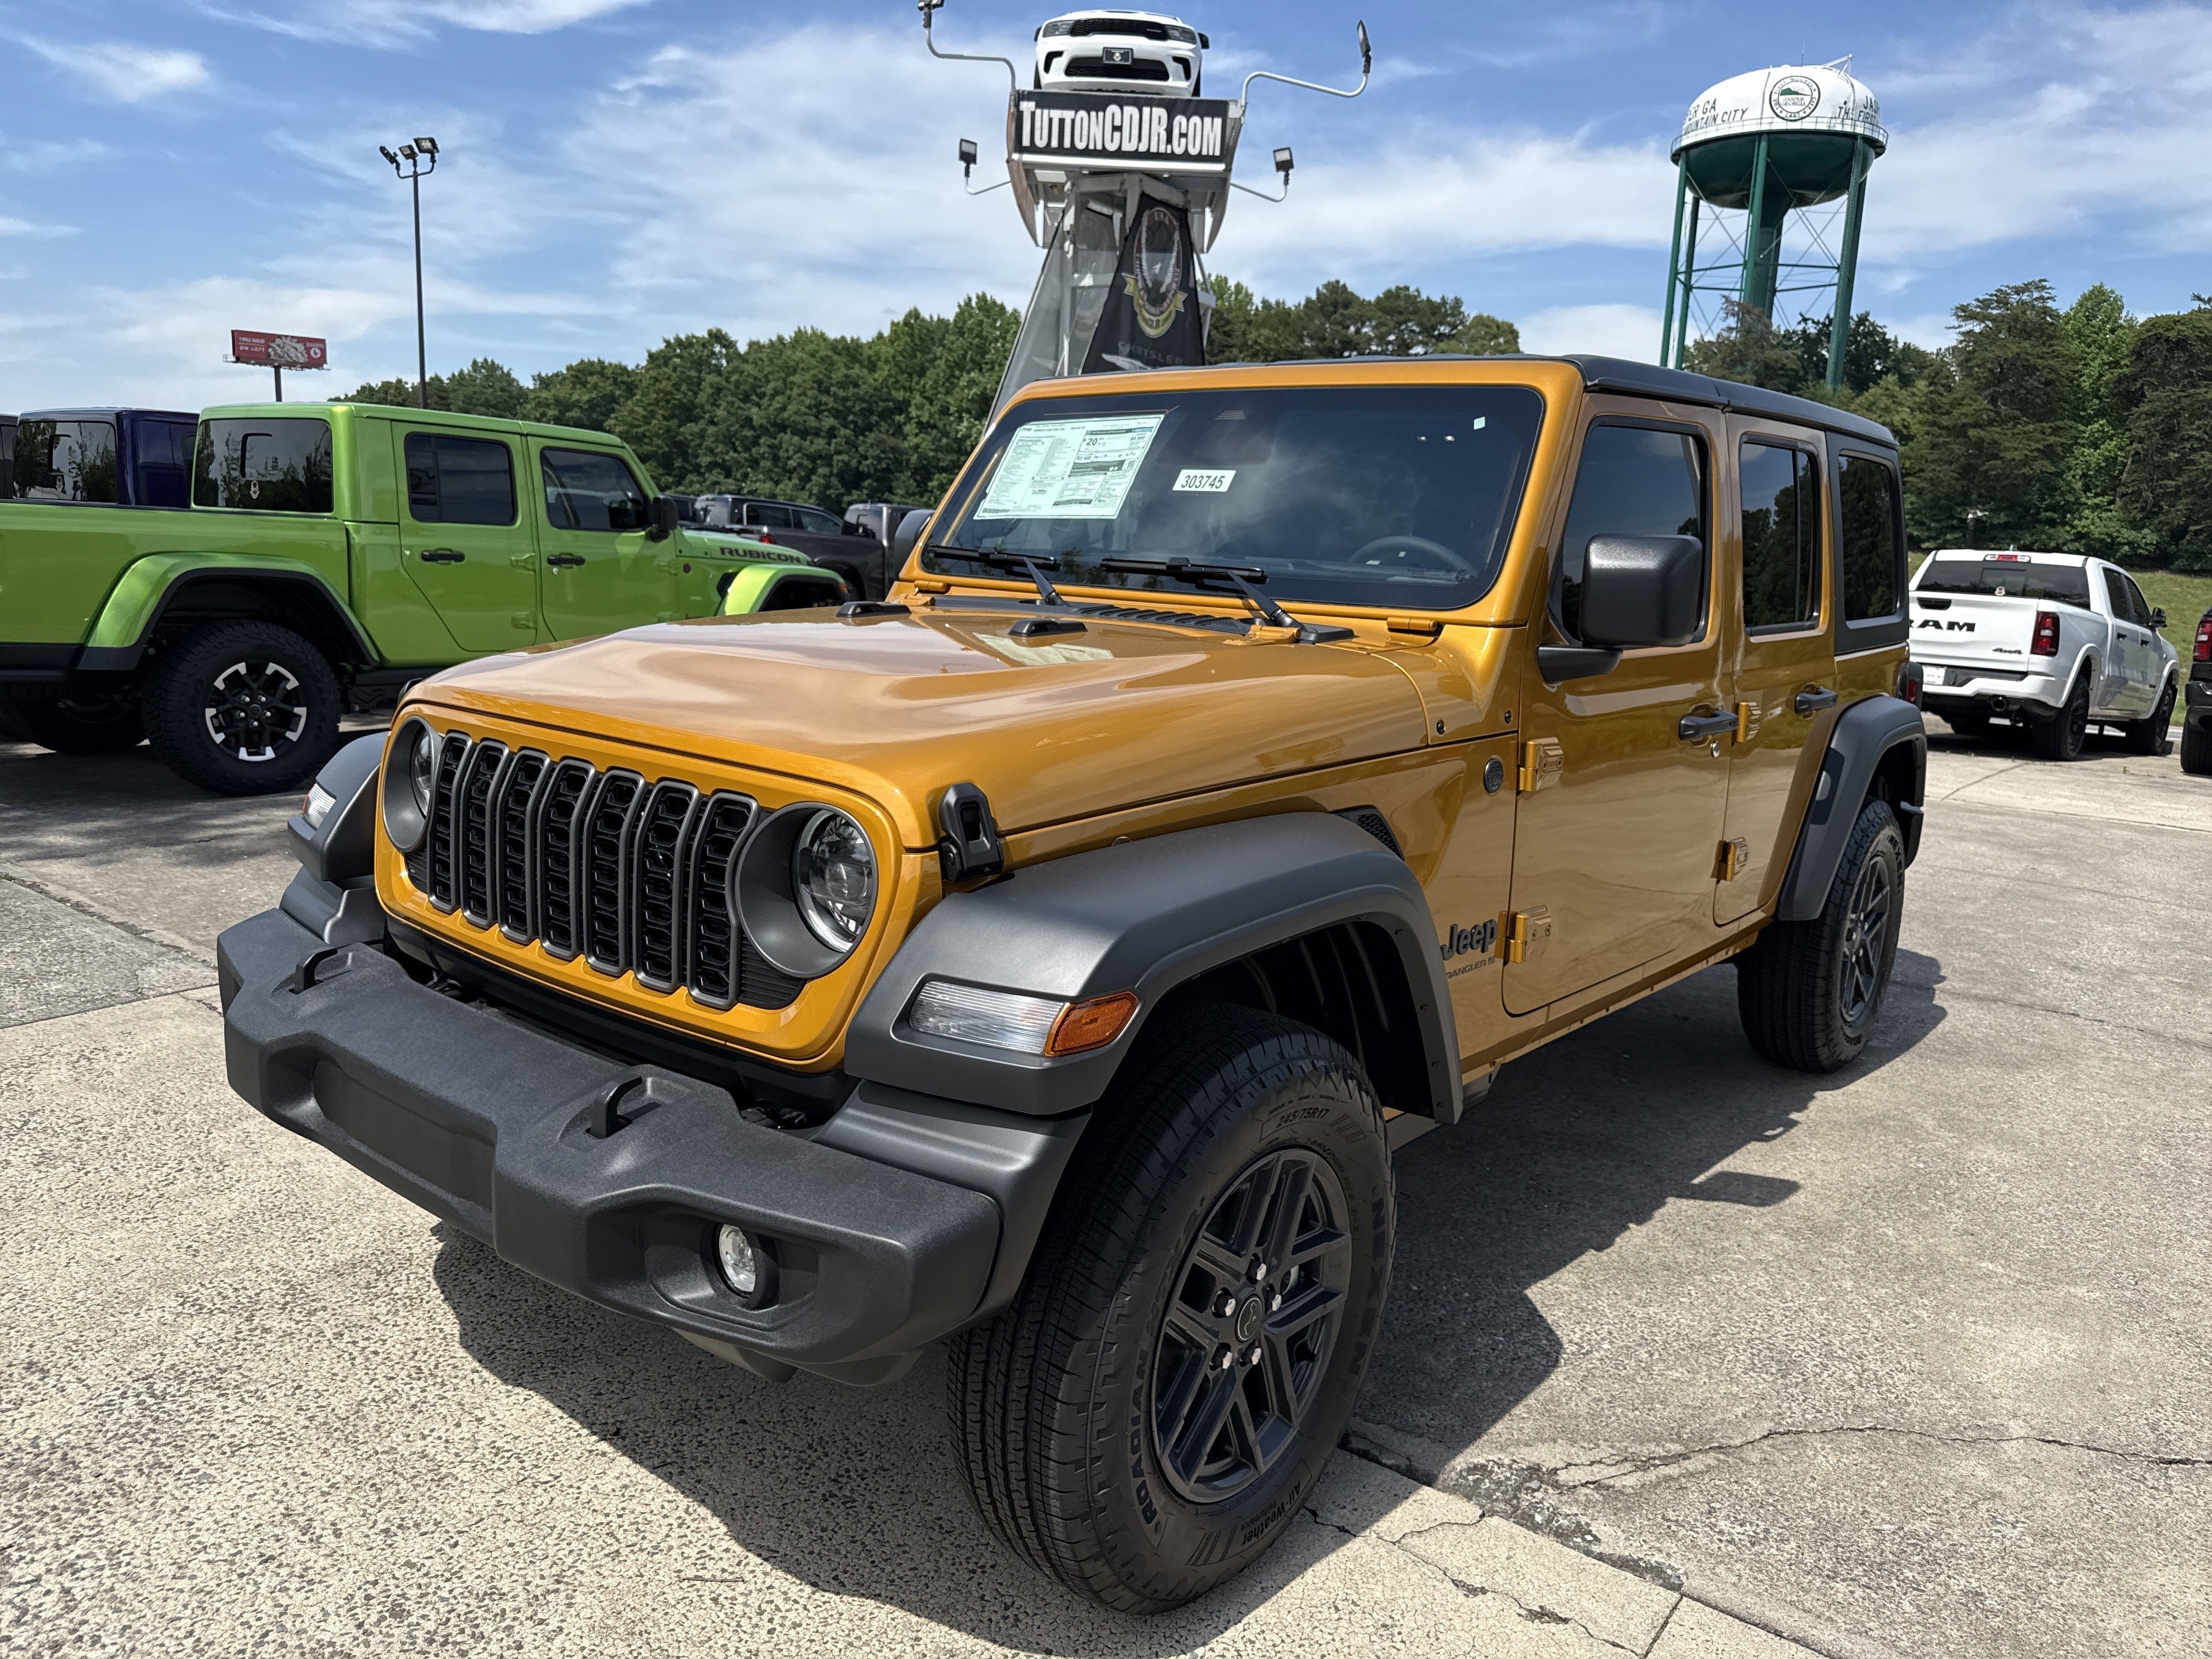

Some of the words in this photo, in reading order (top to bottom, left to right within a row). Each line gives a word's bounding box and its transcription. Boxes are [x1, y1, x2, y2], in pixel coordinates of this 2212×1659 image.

[1702, 98, 1717, 115] GA
[1721, 107, 1749, 123] CITY
[1019, 101, 1222, 156] TUTTONCDJR.COM
[1086, 438, 1098, 446] 20
[1181, 475, 1226, 489] 303745
[719, 547, 802, 563] RUBICON
[1440, 919, 1498, 961] Jeep
[1446, 958, 1486, 979] RANGLER
[1276, 1107, 1330, 1128] 245/75R17
[1348, 1195, 1386, 1376] NEXEN
[1129, 1348, 1159, 1526] ROADIAN
[1240, 1480, 1301, 1547] All-Weather
[1240, 1498, 1277, 1532] Performance
